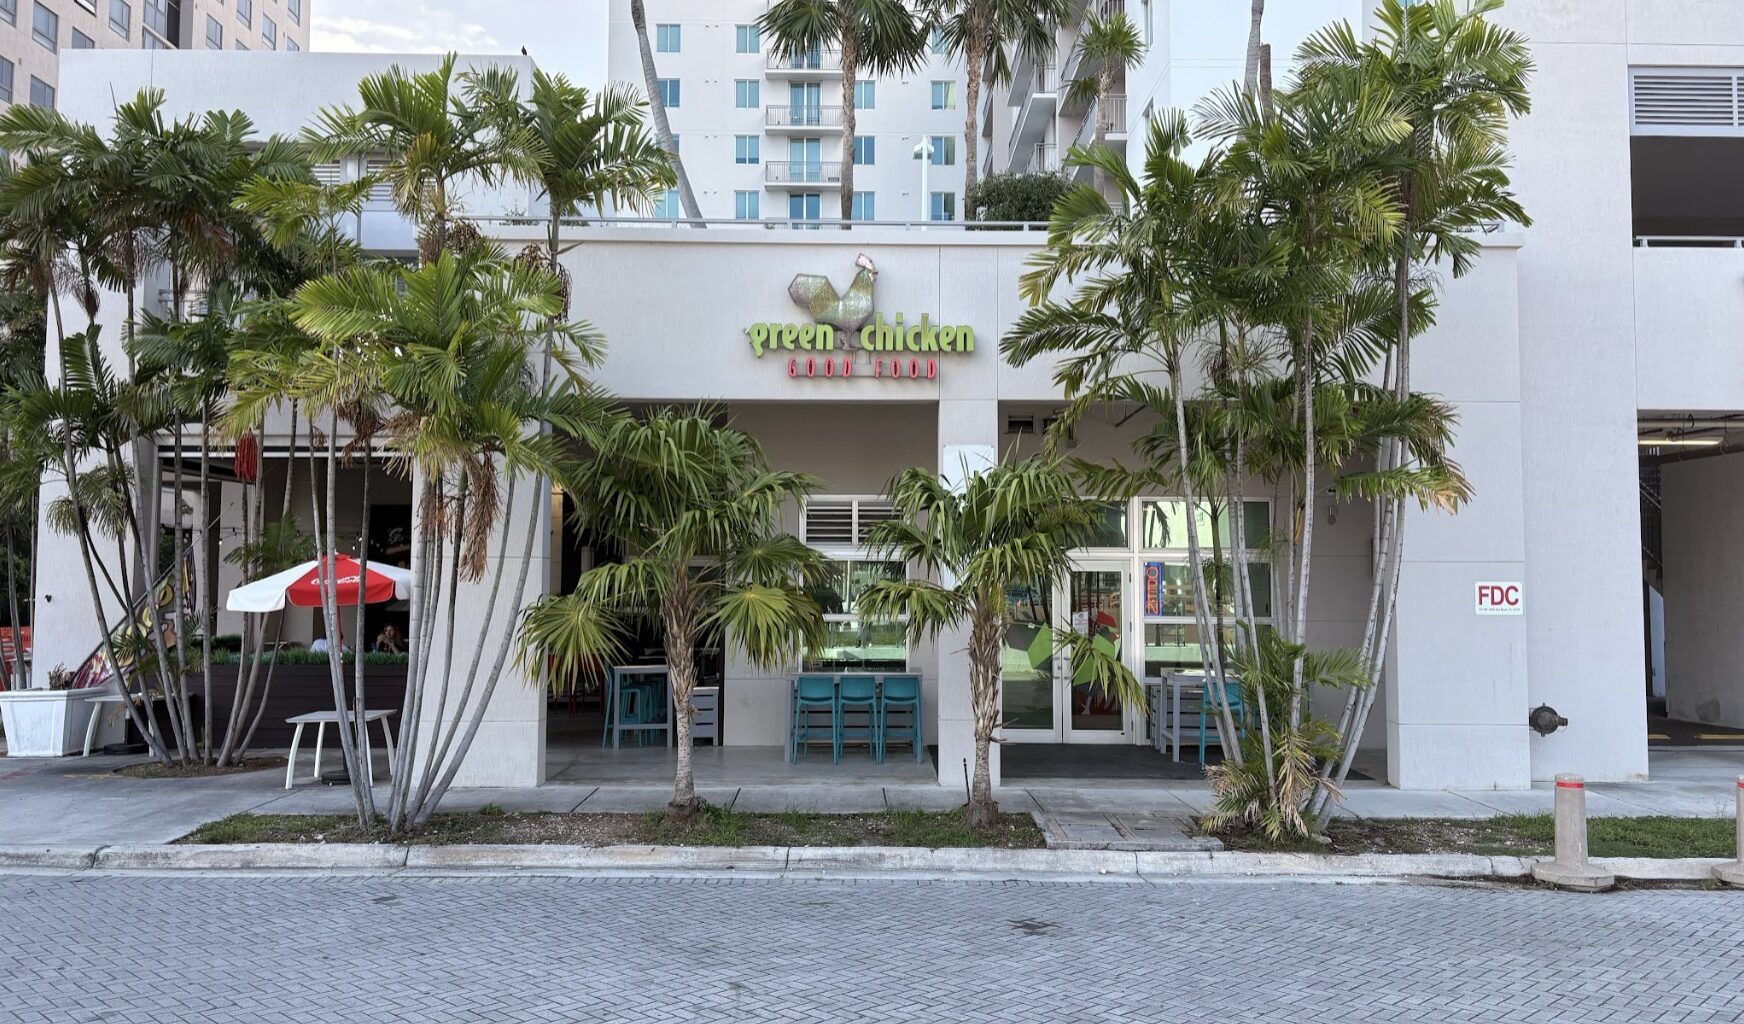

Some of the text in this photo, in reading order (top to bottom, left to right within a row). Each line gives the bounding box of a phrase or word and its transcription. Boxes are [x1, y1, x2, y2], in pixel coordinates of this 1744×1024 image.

[749, 312, 975, 357] green chicken
[788, 357, 937, 379] GOOD FOOD
[1146, 566, 1158, 614] OPEN
[1478, 585, 1519, 606] FDC
